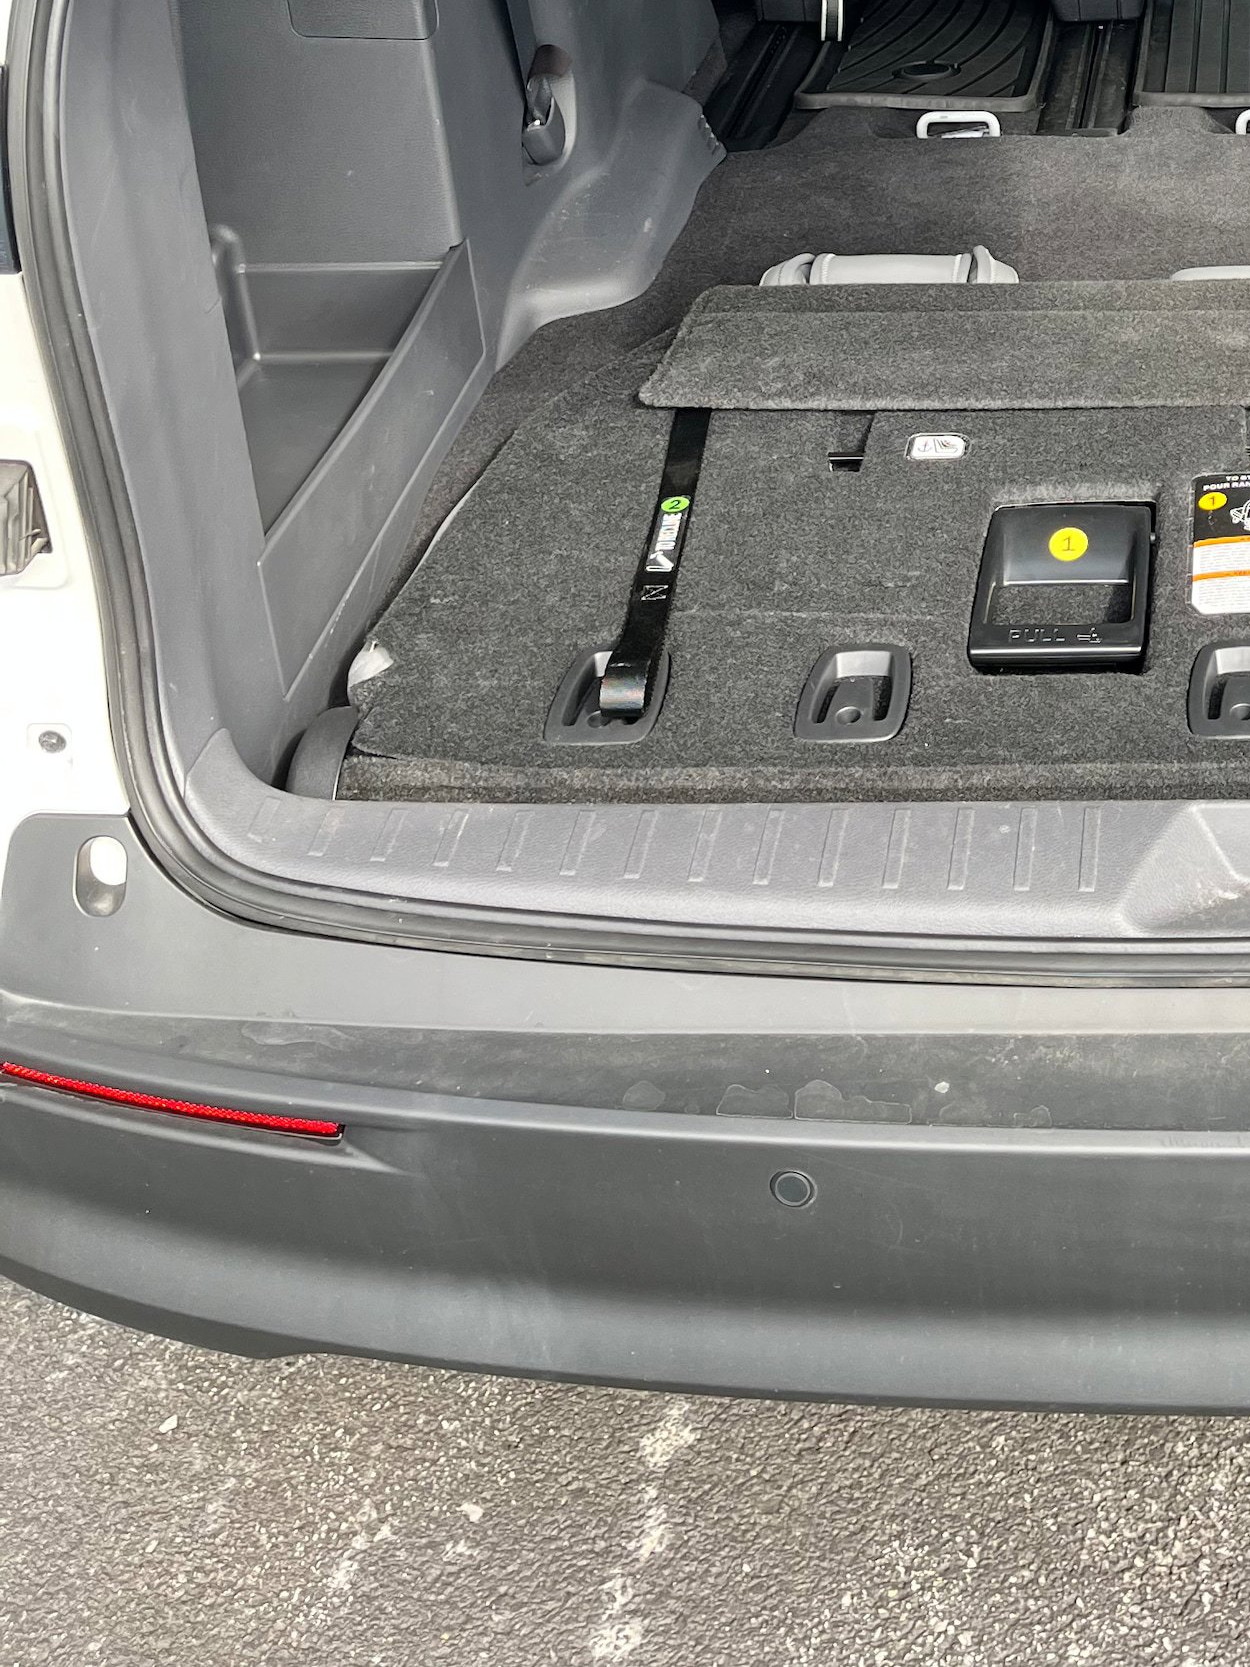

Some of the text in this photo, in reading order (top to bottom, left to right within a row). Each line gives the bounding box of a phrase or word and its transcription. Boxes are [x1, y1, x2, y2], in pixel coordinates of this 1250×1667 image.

[1203, 481, 1231, 491] POUR
[1061, 536, 1076, 552] 1
[1009, 628, 1066, 643] PULL
